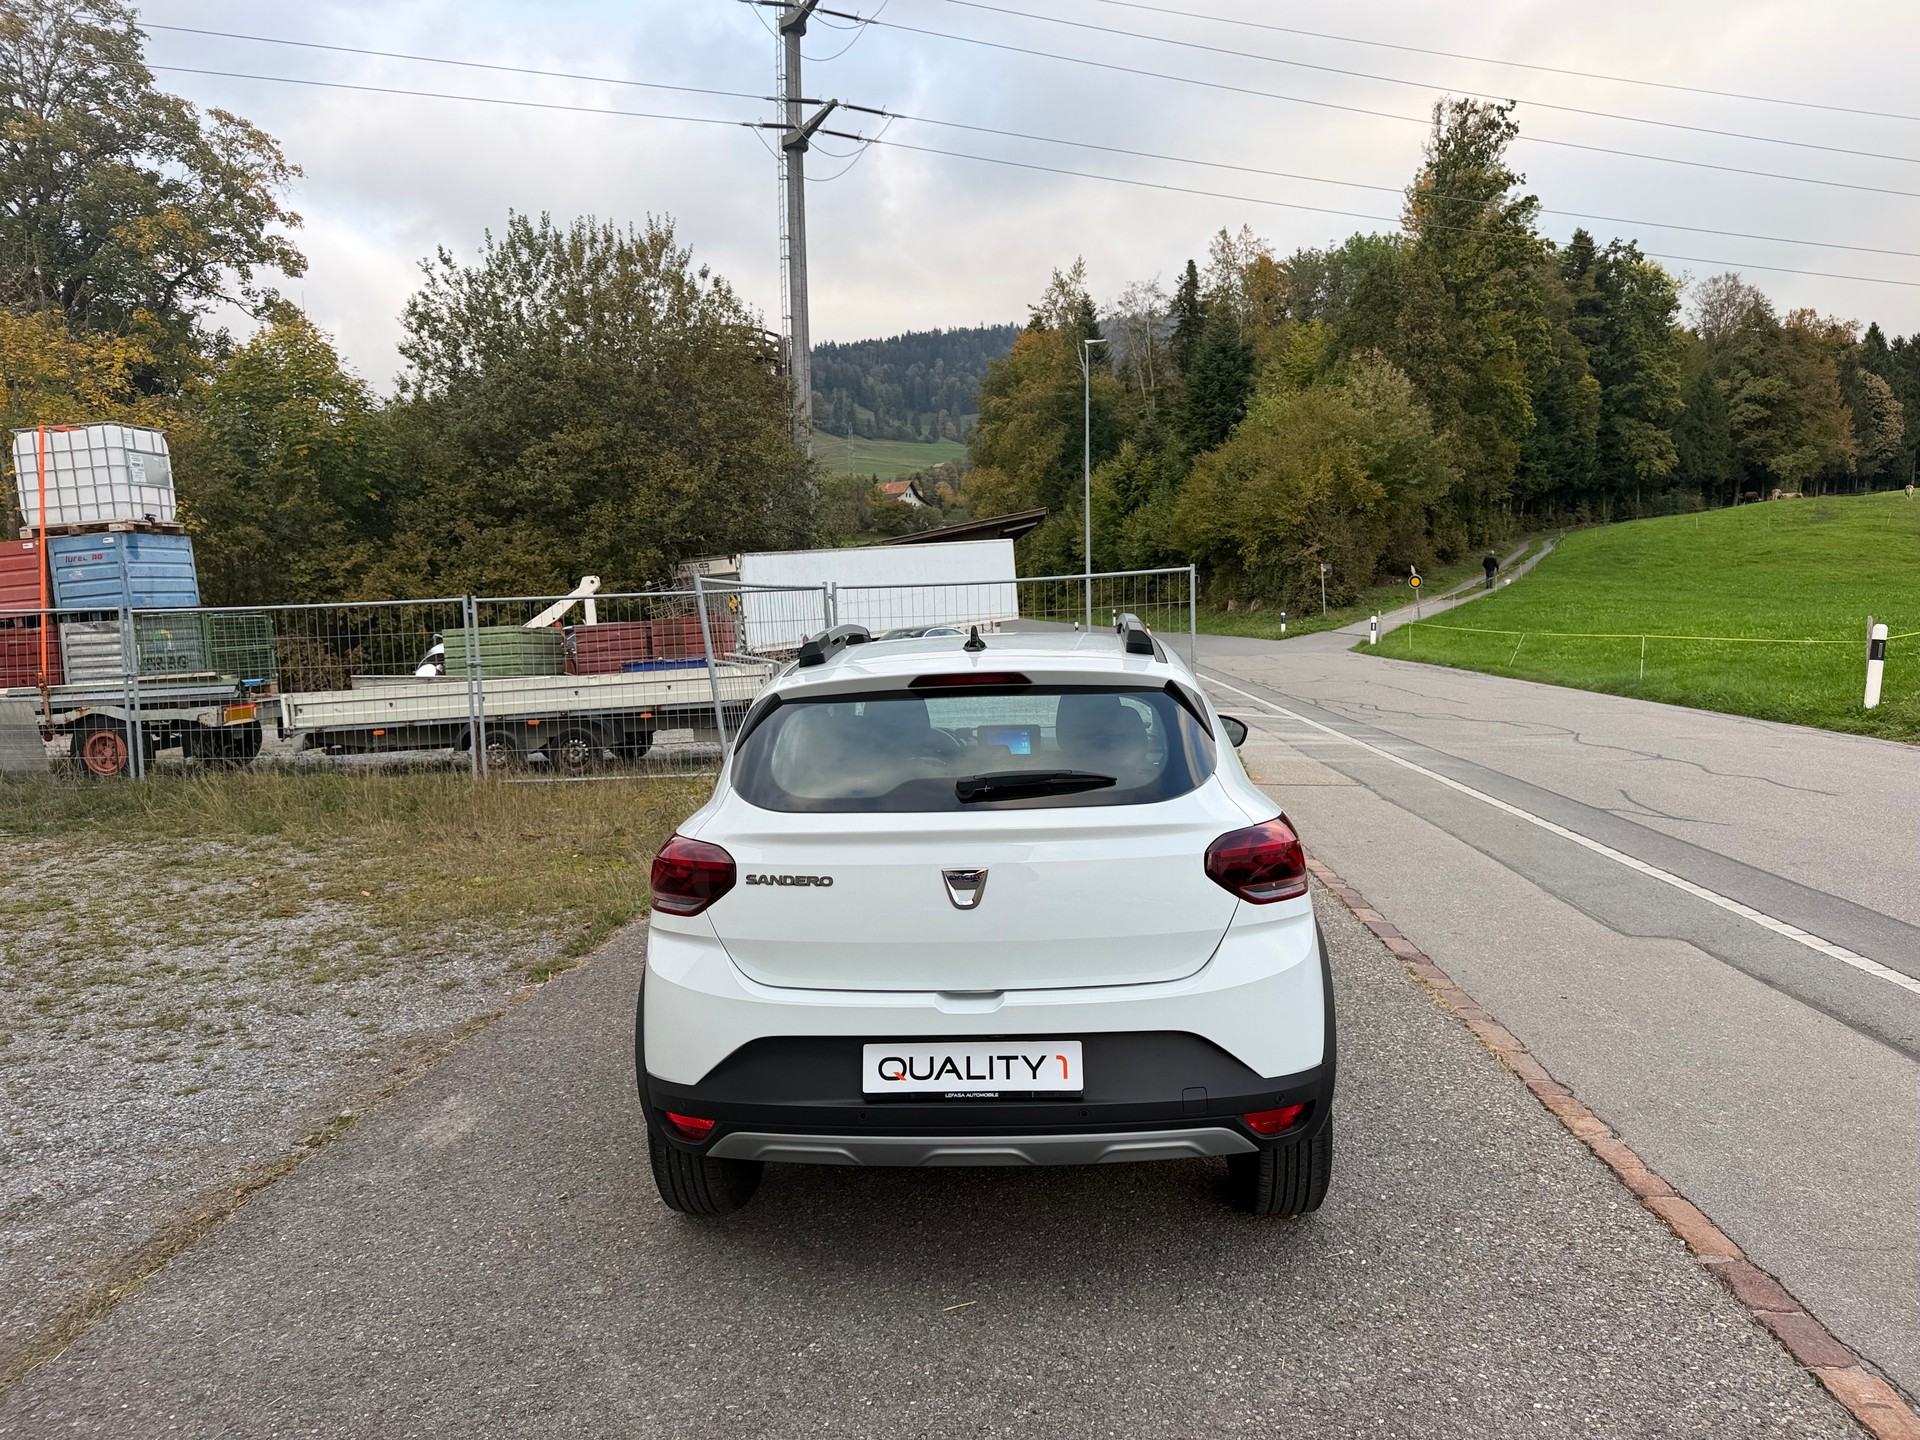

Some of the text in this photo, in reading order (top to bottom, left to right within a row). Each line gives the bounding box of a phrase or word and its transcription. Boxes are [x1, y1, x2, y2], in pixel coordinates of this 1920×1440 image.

[745, 874, 834, 887] SANDERO
[878, 1055, 1068, 1081] QUALITY 1
